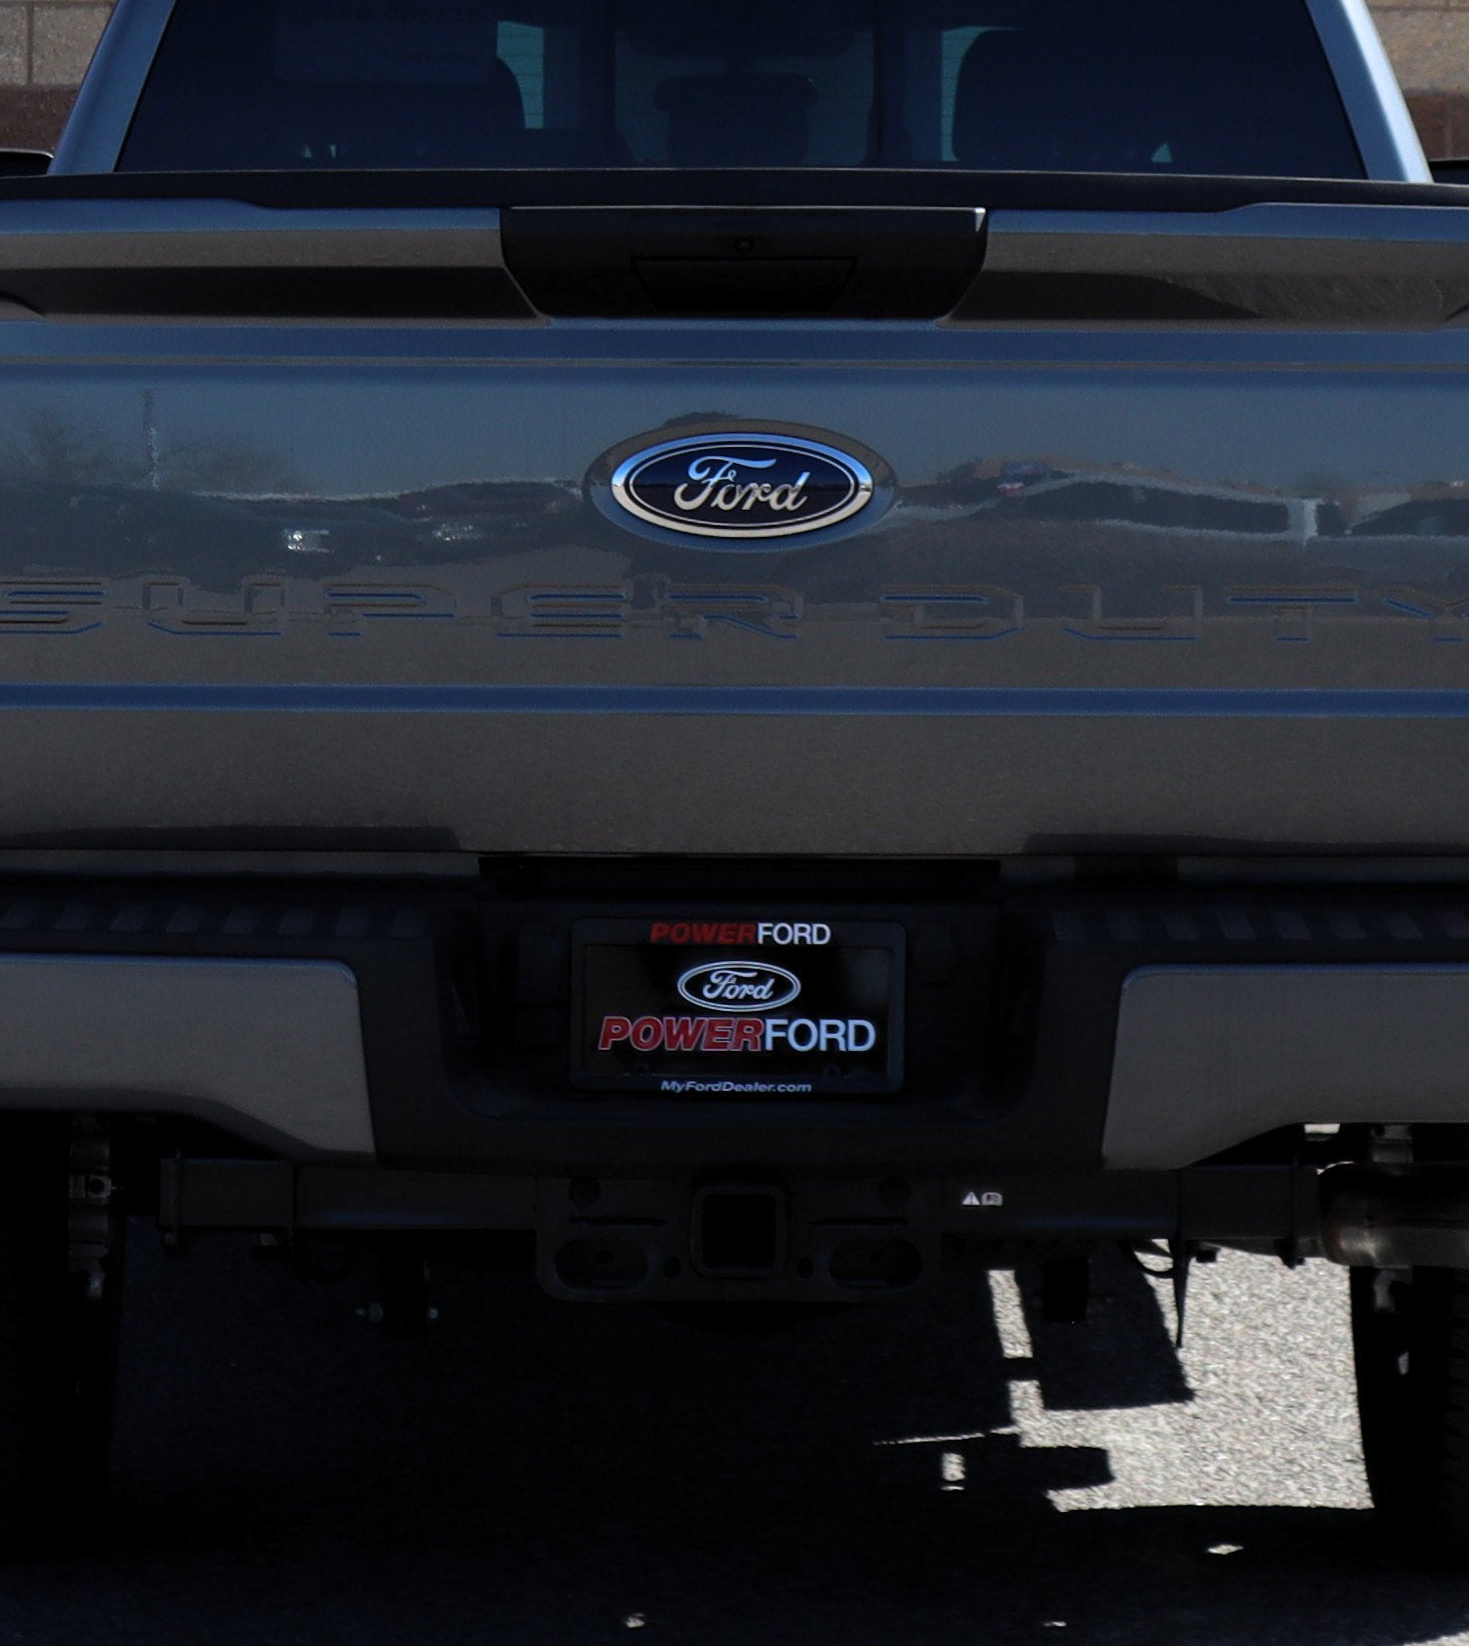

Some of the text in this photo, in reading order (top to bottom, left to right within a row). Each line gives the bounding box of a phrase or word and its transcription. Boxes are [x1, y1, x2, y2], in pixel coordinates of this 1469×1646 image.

[673, 454, 811, 512] Ford
[703, 969, 774, 1000] Ford
[660, 1079, 813, 1094] MyFordDealer.com
